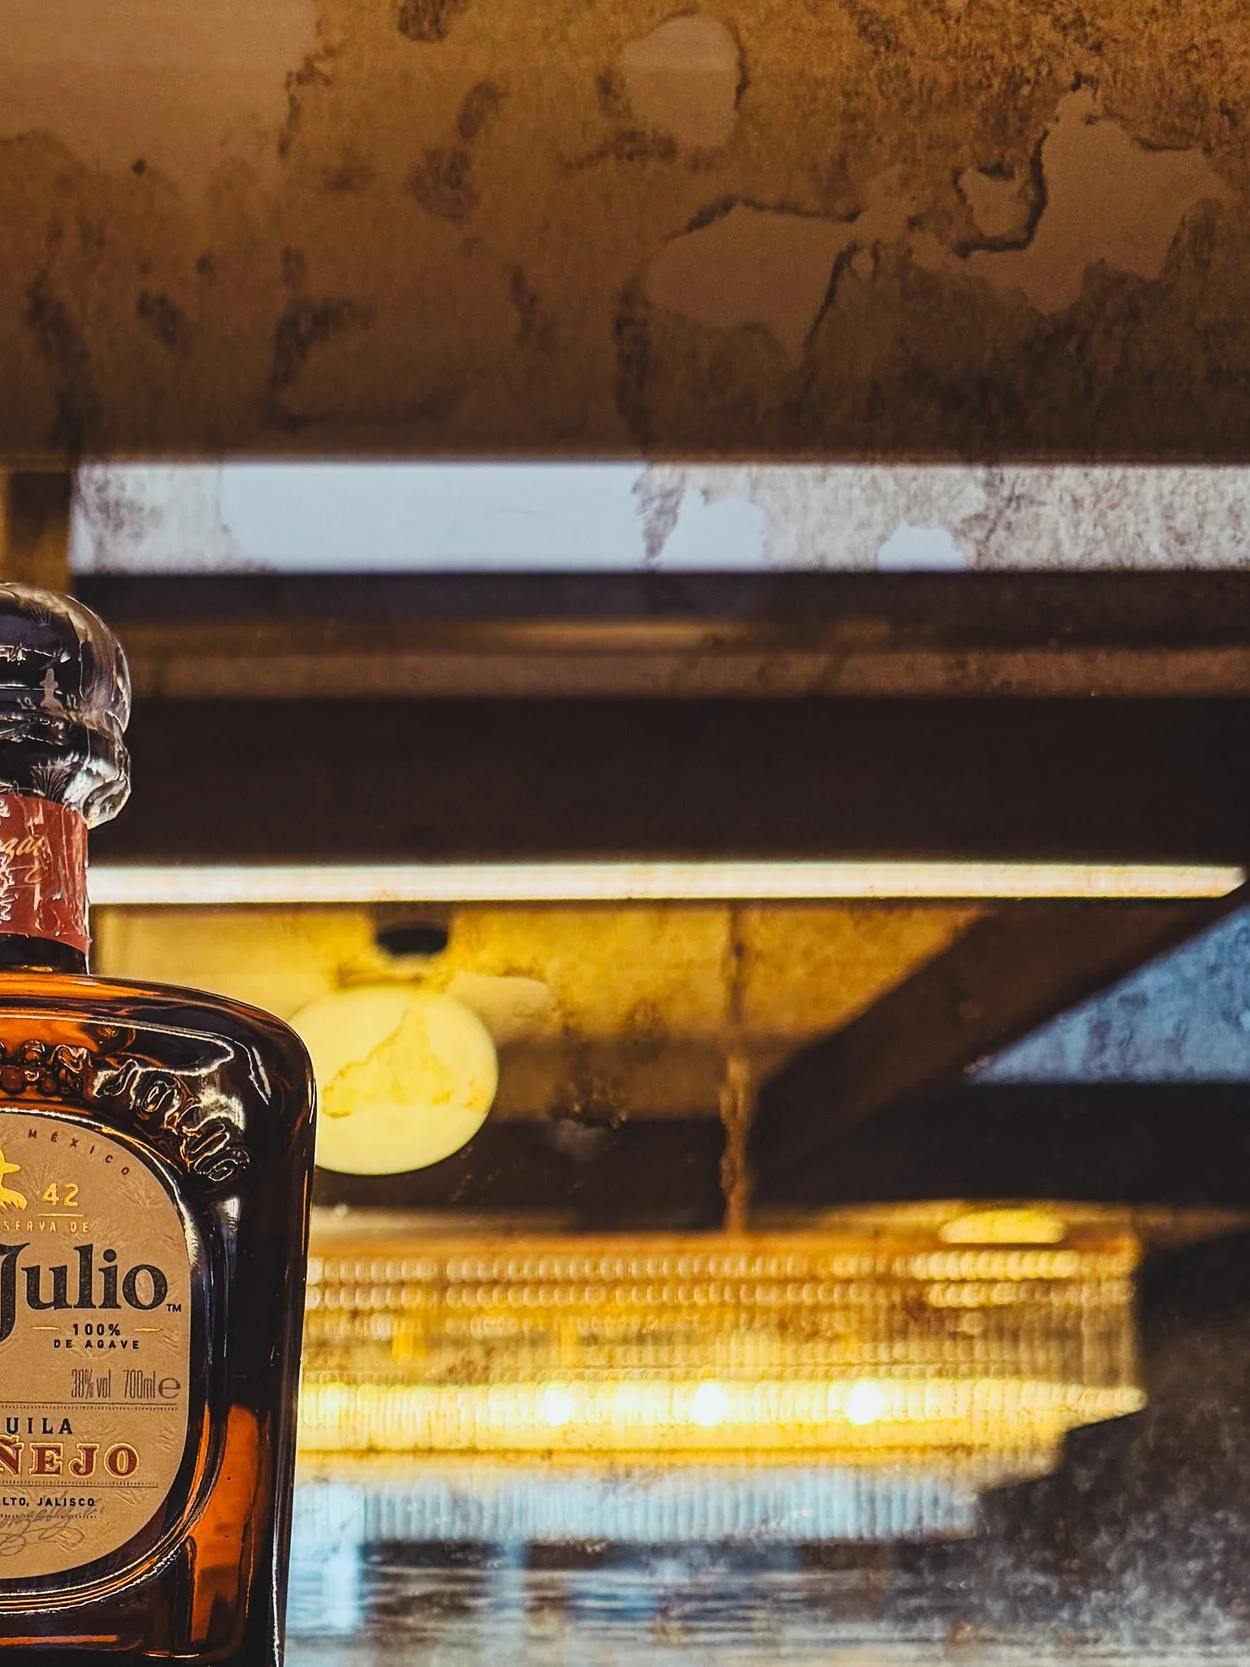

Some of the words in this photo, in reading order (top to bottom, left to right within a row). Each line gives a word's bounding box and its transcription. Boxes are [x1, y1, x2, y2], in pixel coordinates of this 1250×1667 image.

[28, 1128, 130, 1176] MÉXICO
[41, 1182, 80, 1208] 42
[69, 1221, 90, 1233] DE
[72, 1323, 121, 1336] 100%
[53, 1339, 73, 1349] DE
[85, 1340, 140, 1350] AGAVE
[96, 1368, 111, 1399] vol
[36, 1497, 96, 1508] JALISCO
